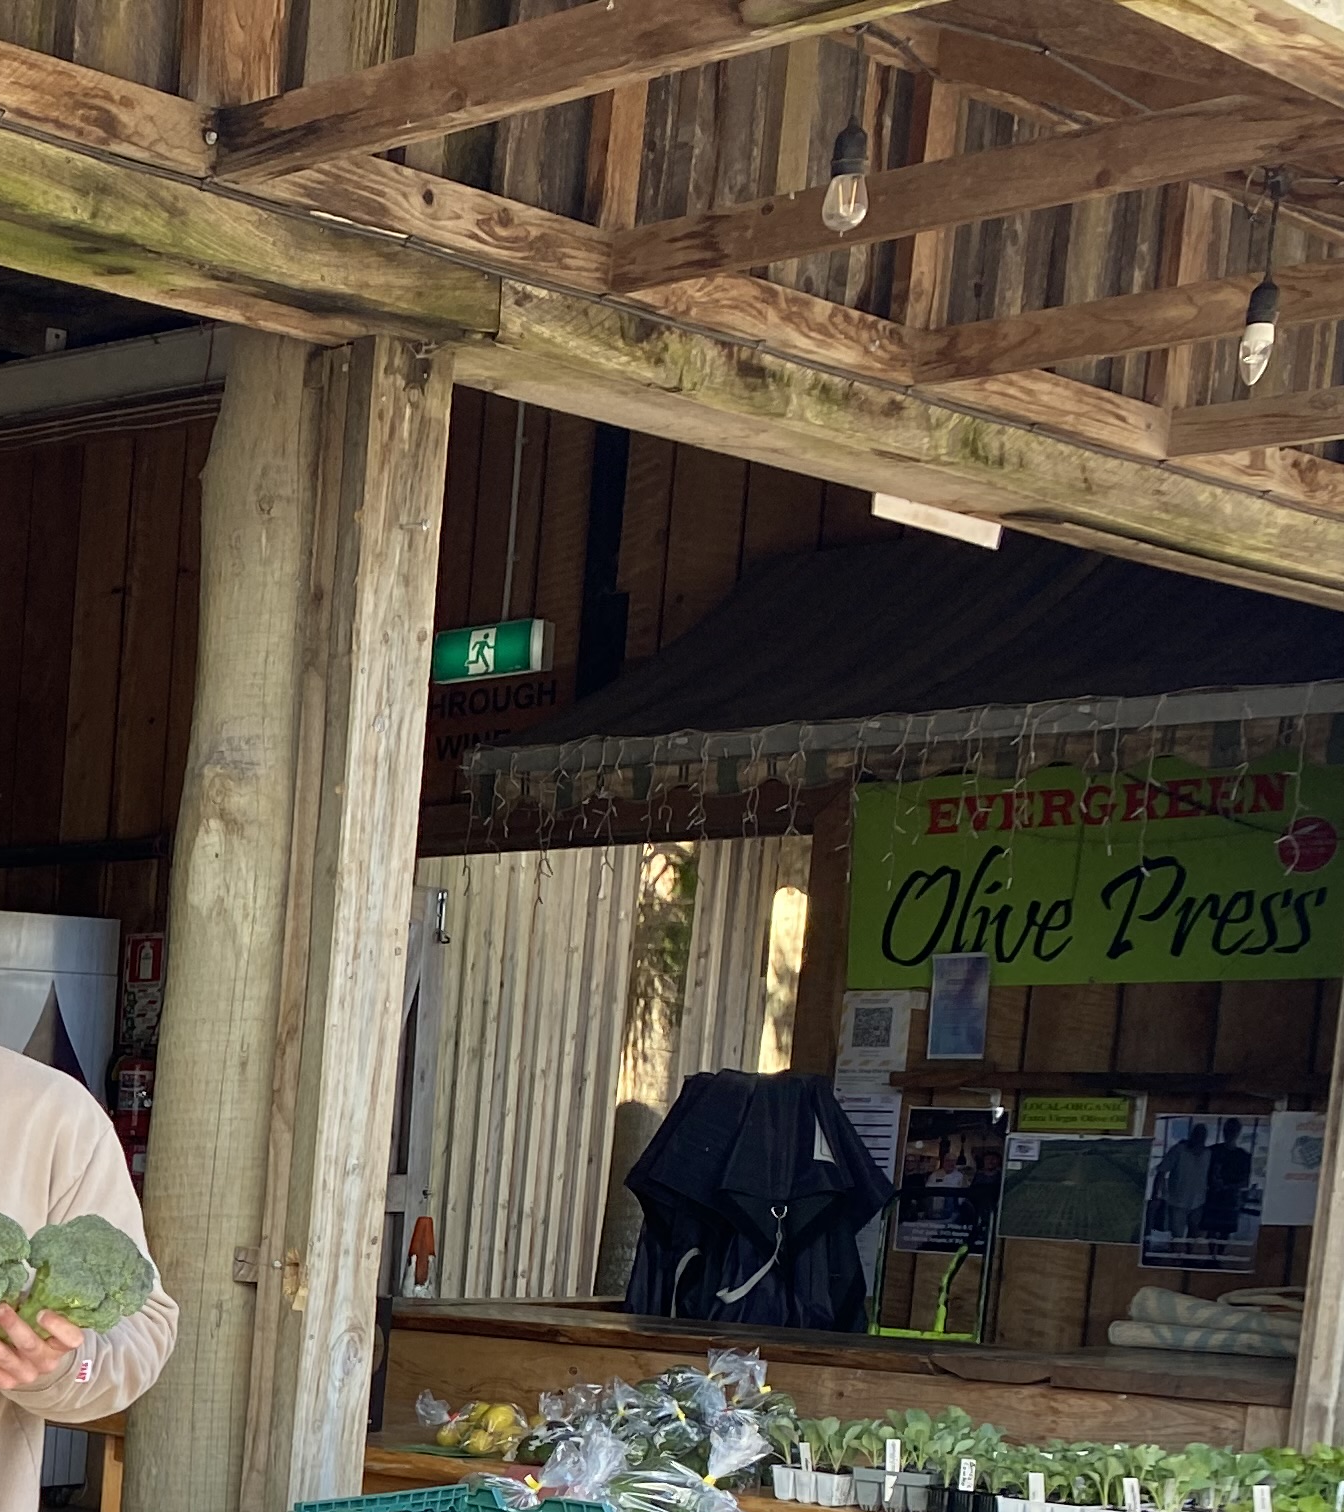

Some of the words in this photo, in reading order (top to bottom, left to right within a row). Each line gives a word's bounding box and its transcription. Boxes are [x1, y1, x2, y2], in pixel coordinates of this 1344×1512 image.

[924, 772, 1290, 835] EVERGREEN
[882, 845, 1074, 967] Olive
[1100, 855, 1328, 960] Press
